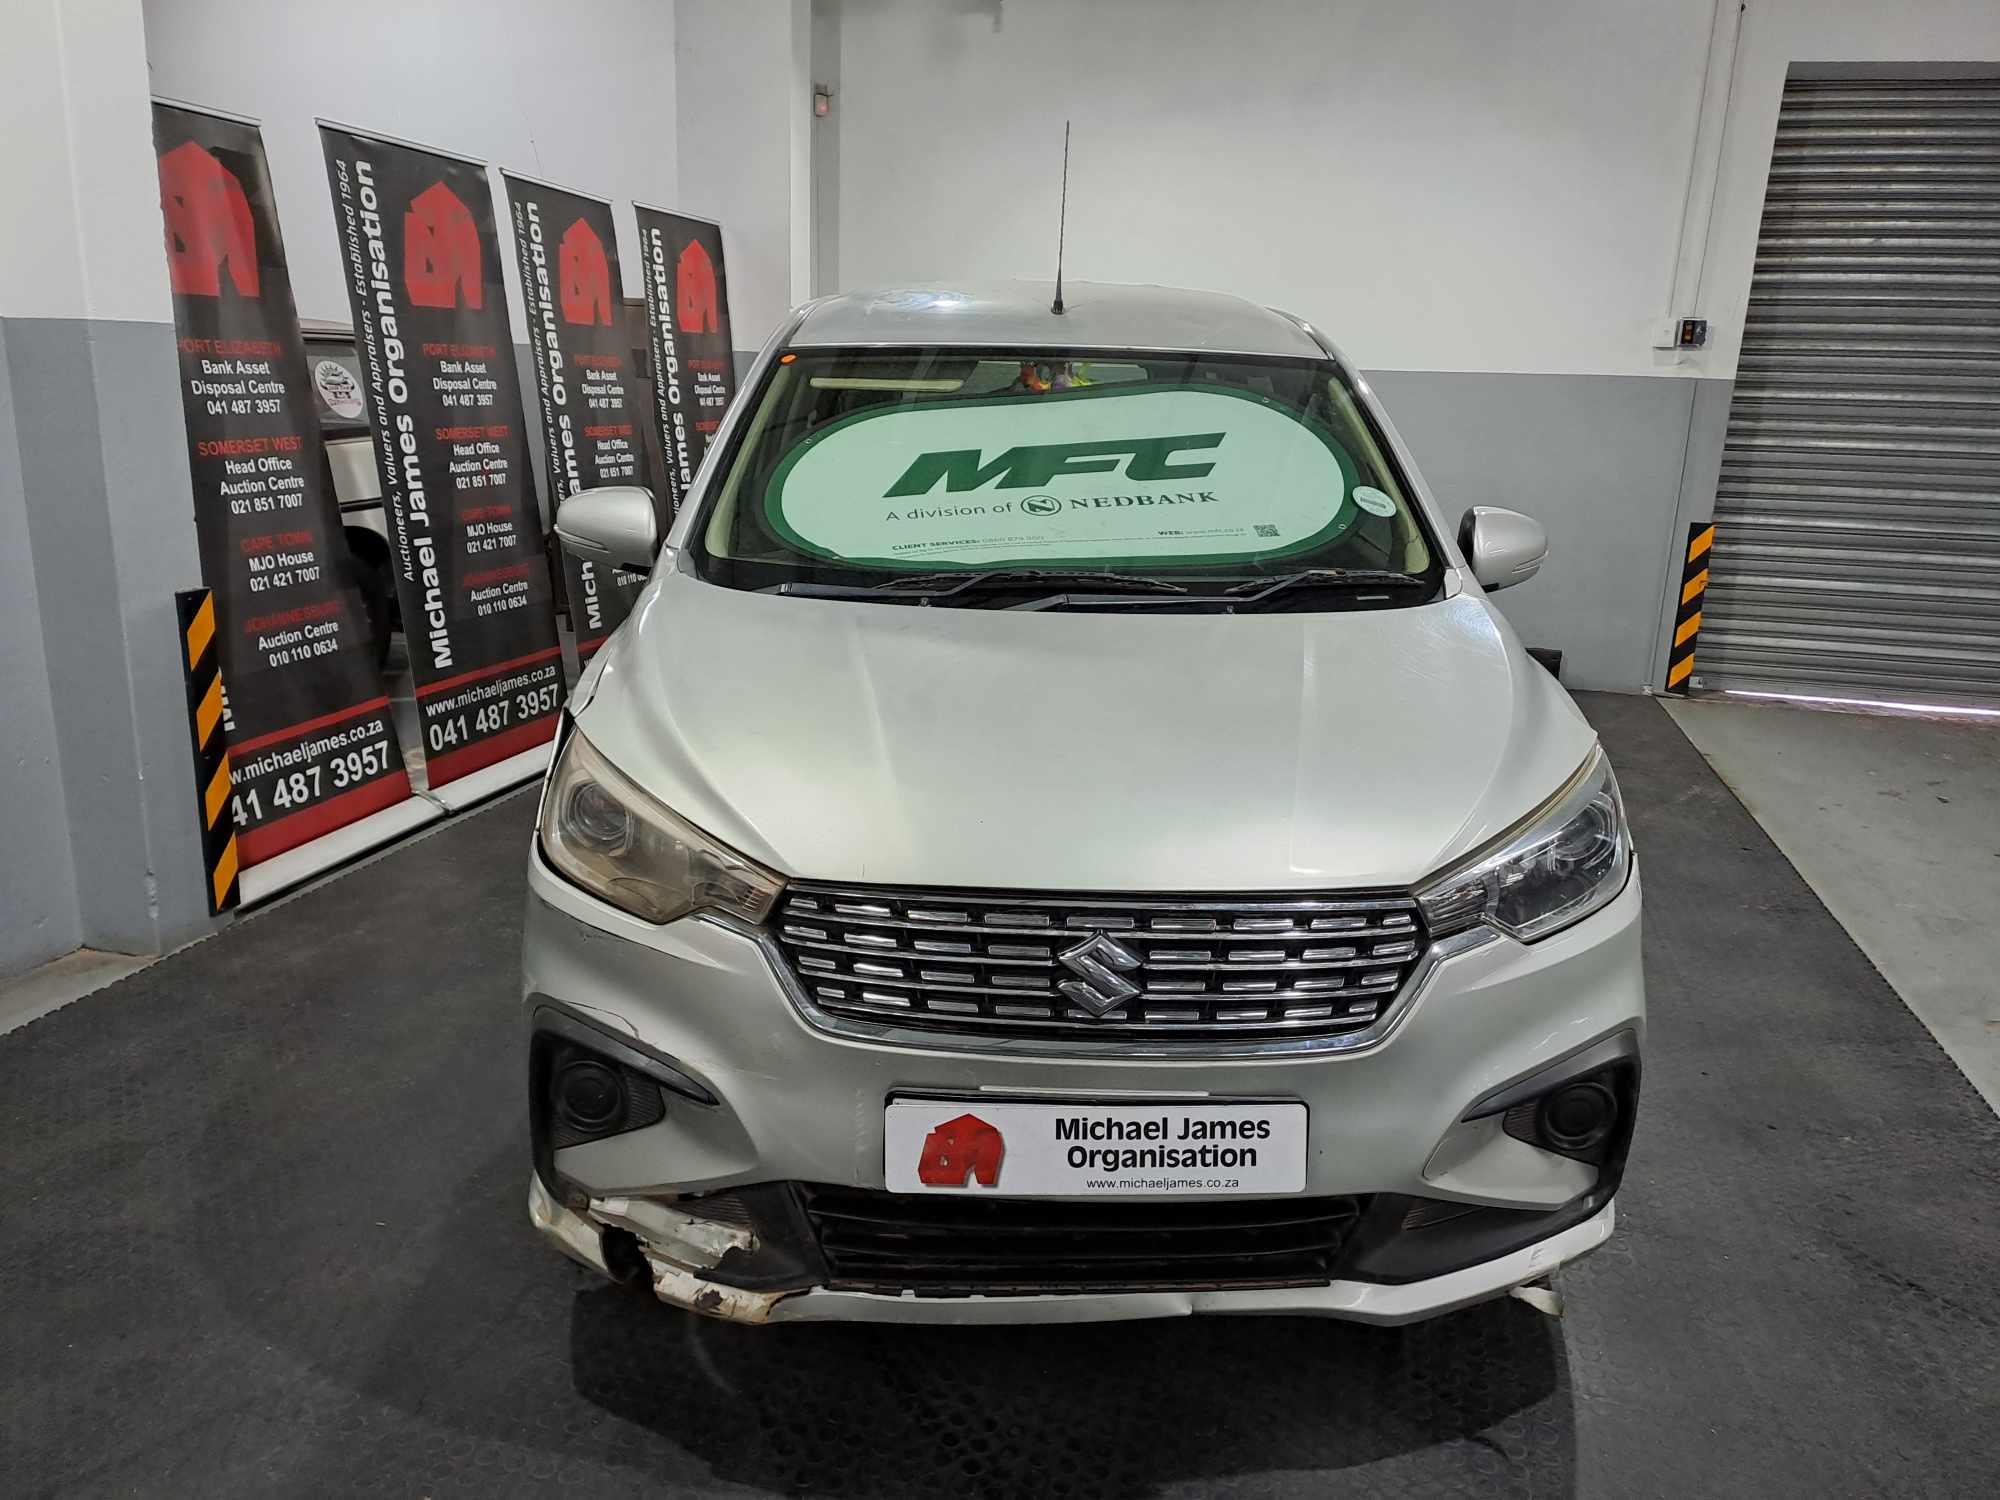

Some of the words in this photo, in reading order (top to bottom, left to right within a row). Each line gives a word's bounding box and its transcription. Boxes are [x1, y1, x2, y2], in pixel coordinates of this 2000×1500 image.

[335, 159, 352, 199] 1964
[341, 203, 367, 297] Established
[355, 160, 408, 405] Organisation
[518, 238, 536, 315] Established
[526, 201, 567, 406] Organisation
[651, 228, 681, 405] Organisation
[361, 309, 384, 393] Appraisers
[533, 327, 551, 396] Appraisers
[201, 360, 234, 374] Bank
[236, 360, 271, 374] Asset
[439, 361, 462, 373] Bank
[464, 361, 487, 373] Asset
[191, 380, 246, 397] Disposal
[248, 380, 286, 394] Centre
[432, 377, 471, 392] Disposal
[206, 400, 228, 415] 041
[231, 400, 251, 414] 487
[255, 399, 281, 413] 3957
[374, 395, 389, 427] and
[442, 395, 457, 407] 041
[459, 395, 474, 407] 487
[542, 398, 553, 424] and
[657, 397, 669, 421] and
[380, 429, 398, 486] Valuers
[453, 443, 475, 456] Head
[548, 427, 561, 474] Valuers
[558, 414, 582, 496] ames
[663, 423, 674, 464] Valuers
[225, 460, 256, 475] Head
[257, 456, 293, 472] Office
[396, 414, 430, 528] James
[449, 460, 482, 474] Auction
[882, 432, 1226, 498] MFC
[220, 479, 266, 496] Auction
[268, 475, 305, 490] Centre
[455, 477, 470, 490] 021
[231, 500, 252, 515] 021
[254, 496, 276, 512] 851
[277, 493, 303, 509] 7007
[885, 510, 900, 521] A
[907, 504, 986, 521] division
[993, 502, 1012, 514] of
[1070, 490, 1220, 510] NEDBANK
[391, 490, 415, 582] Auctioneers,
[466, 523, 486, 537] MJO
[487, 521, 513, 534] House
[466, 541, 482, 554] 021
[482, 537, 497, 551] 421
[248, 555, 275, 572] MJO
[277, 551, 314, 568] House
[250, 575, 271, 592] 021
[272, 571, 294, 588] 421
[295, 567, 320, 584] 7007
[470, 587, 502, 602] Auction
[413, 536, 453, 669] Michael
[477, 602, 492, 617] 010
[492, 599, 507, 613] 110
[581, 561, 602, 630] Mich
[258, 630, 302, 651] Auction
[304, 620, 339, 639] Centre
[269, 650, 290, 668] 010
[291, 645, 312, 664] 110
[313, 638, 339, 656] 0634
[425, 664, 557, 718] www.michaeljames.co.za
[429, 714, 468, 751] 041
[475, 700, 509, 733] 487
[515, 683, 559, 720] 3957
[231, 788, 263, 827] 41
[272, 766, 322, 809] 487
[329, 740, 390, 788] 3957
[1054, 1117, 1168, 1141] Michael
[1177, 1118, 1271, 1141] James
[1067, 1144, 1257, 1172] Organisation
[1086, 1176, 1240, 1191] www.michaeljames.co.za
